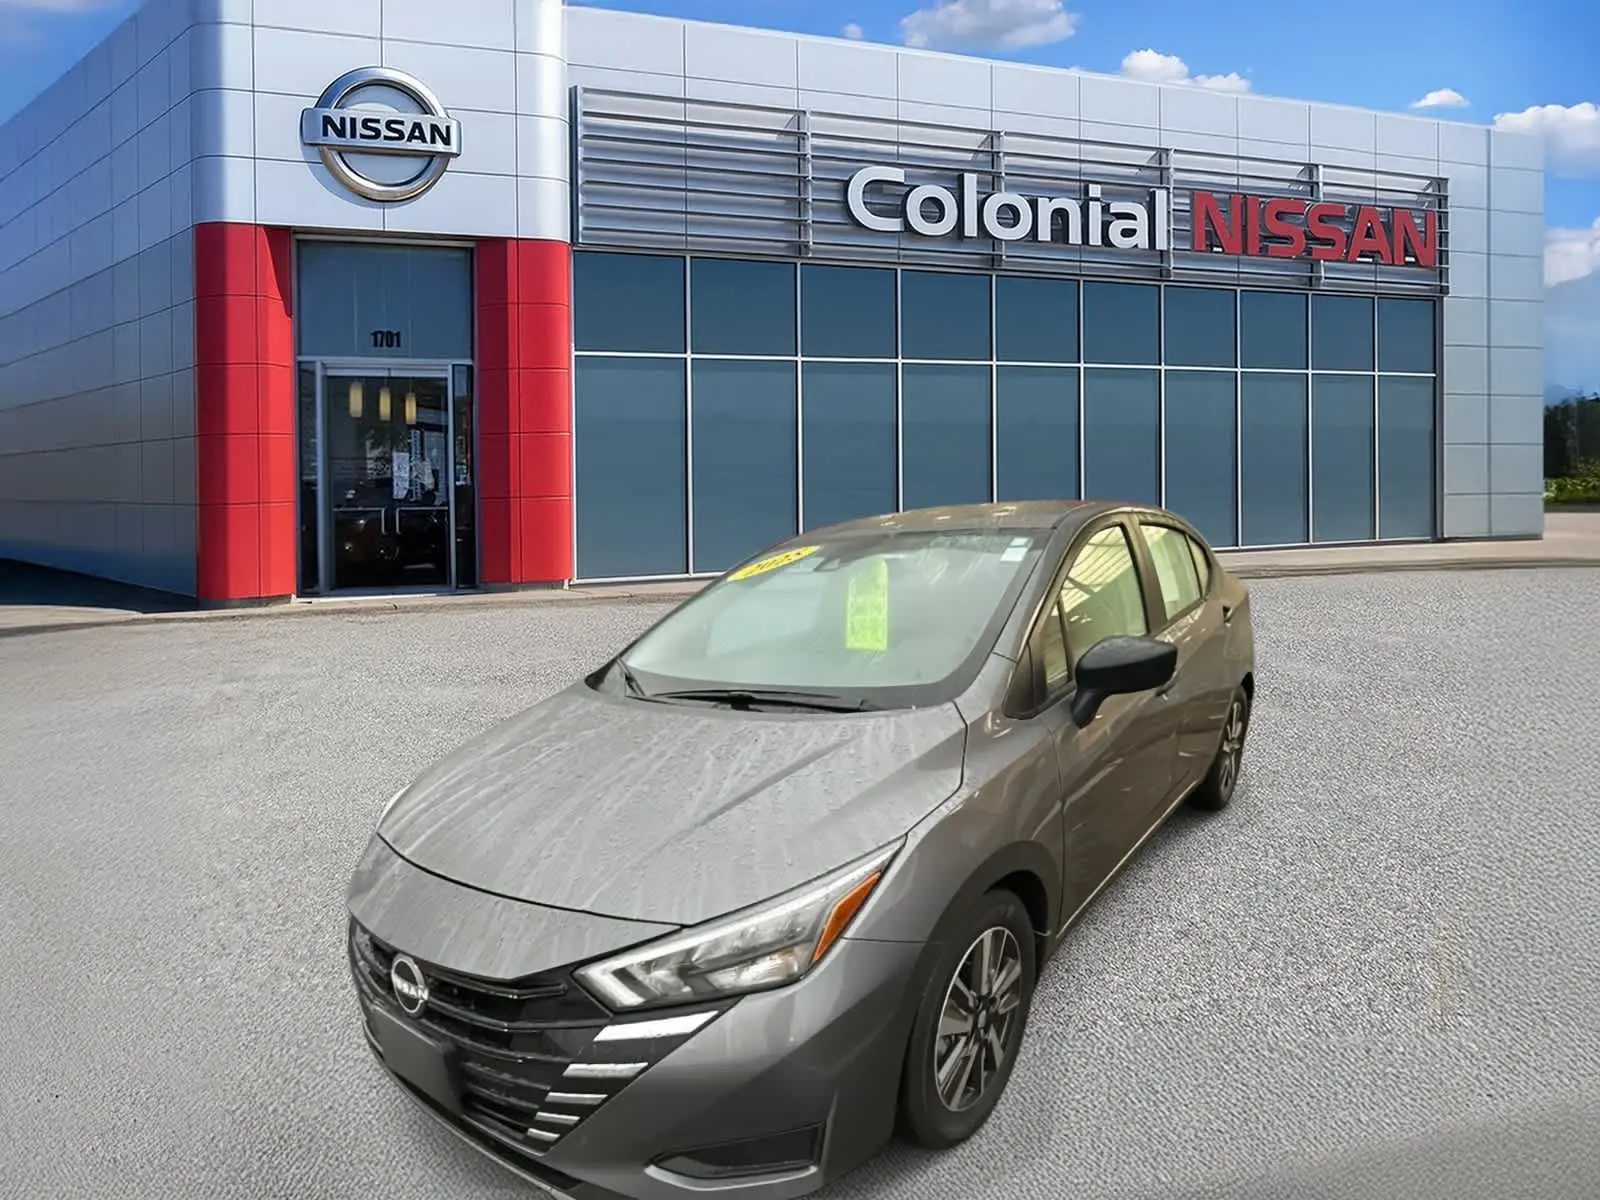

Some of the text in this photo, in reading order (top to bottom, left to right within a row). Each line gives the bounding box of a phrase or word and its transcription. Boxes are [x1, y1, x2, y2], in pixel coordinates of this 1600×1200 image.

[322, 114, 451, 146] NISSAN
[847, 165, 1437, 268] Colonial NISSAN
[370, 330, 401, 348] 1701
